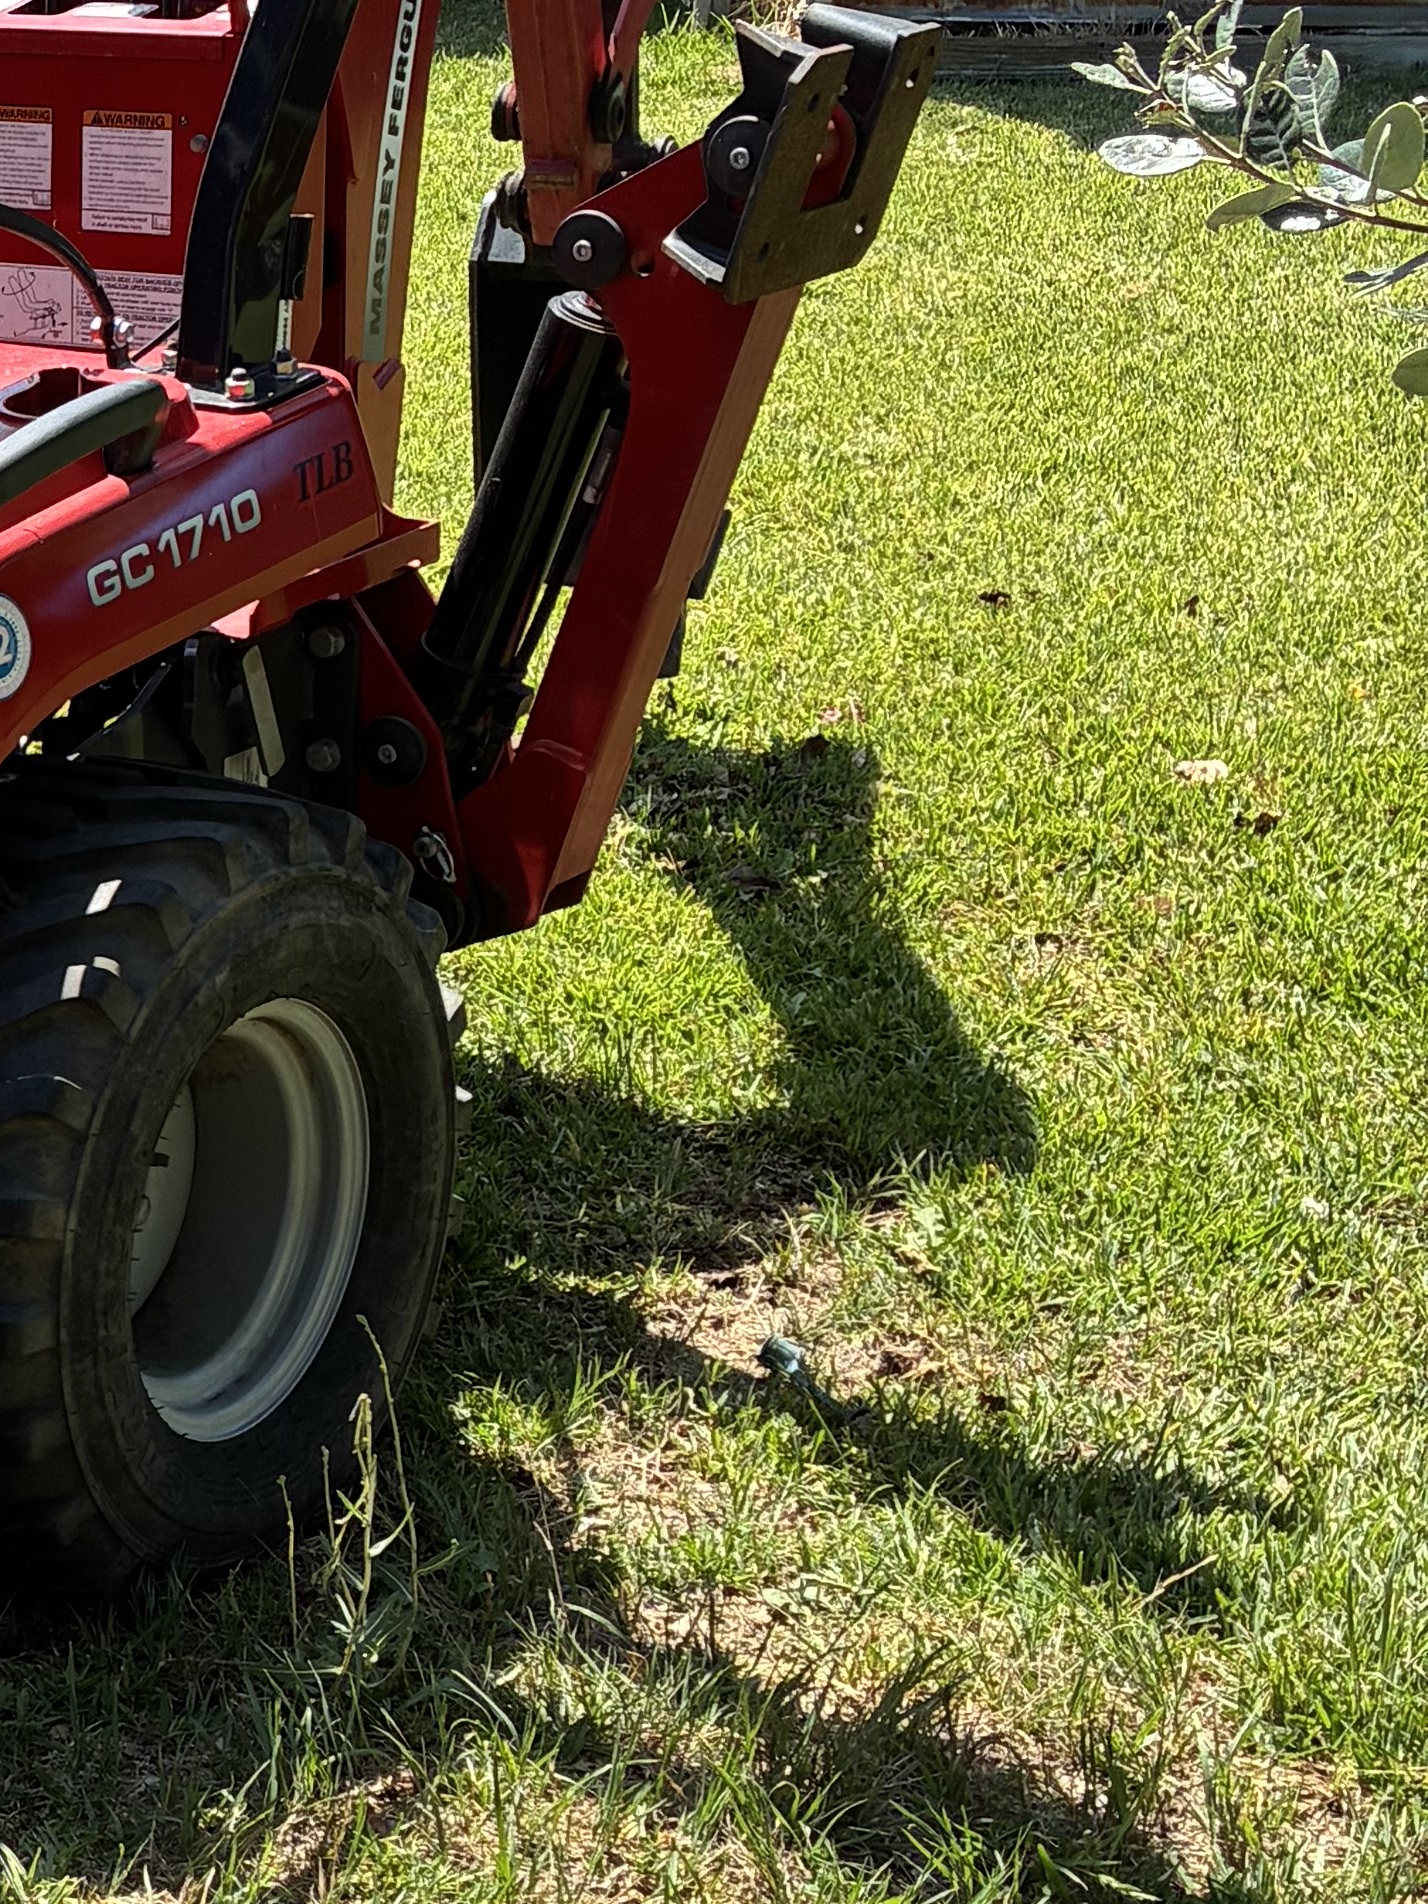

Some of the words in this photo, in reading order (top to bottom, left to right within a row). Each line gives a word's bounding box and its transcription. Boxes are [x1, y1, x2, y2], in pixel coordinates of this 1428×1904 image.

[0, 108, 51, 121] WARNING
[105, 113, 166, 128] WARNING
[369, 151, 396, 335] MASSEY
[294, 440, 354, 503] TLB
